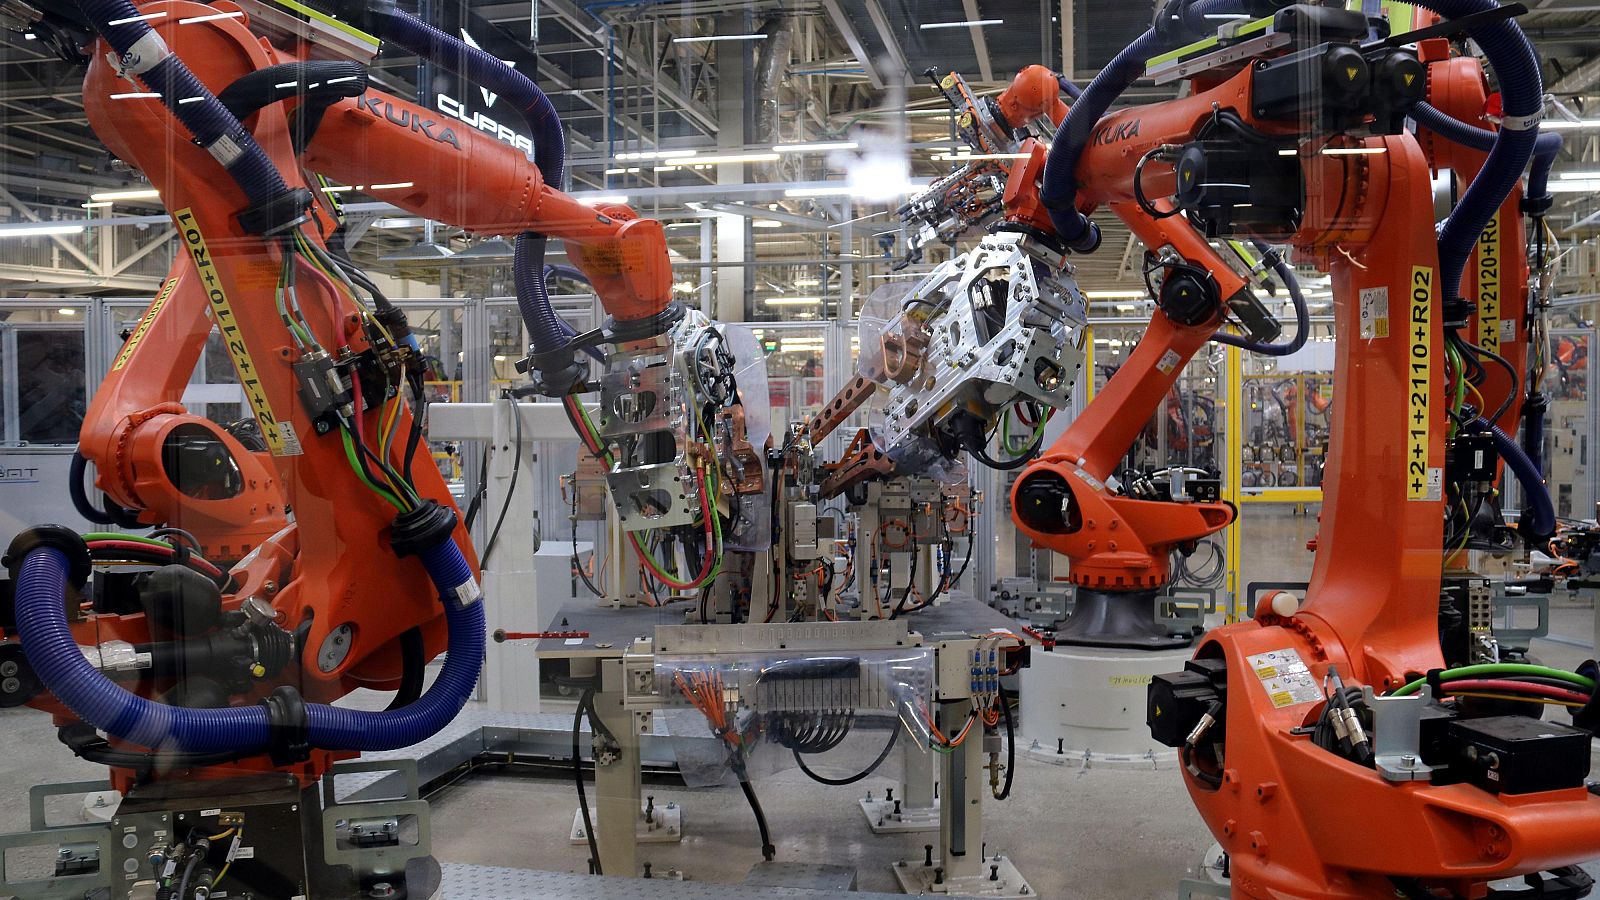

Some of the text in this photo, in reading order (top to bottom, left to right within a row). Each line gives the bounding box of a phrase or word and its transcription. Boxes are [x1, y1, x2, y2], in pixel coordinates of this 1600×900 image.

[357, 94, 461, 150] KUKA
[437, 93, 532, 154] CUPRA
[1093, 119, 1140, 147] KUKA
[178, 213, 278, 443] +2+1+2110+R01
[1410, 271, 1429, 493] +2+1+2110+R02
